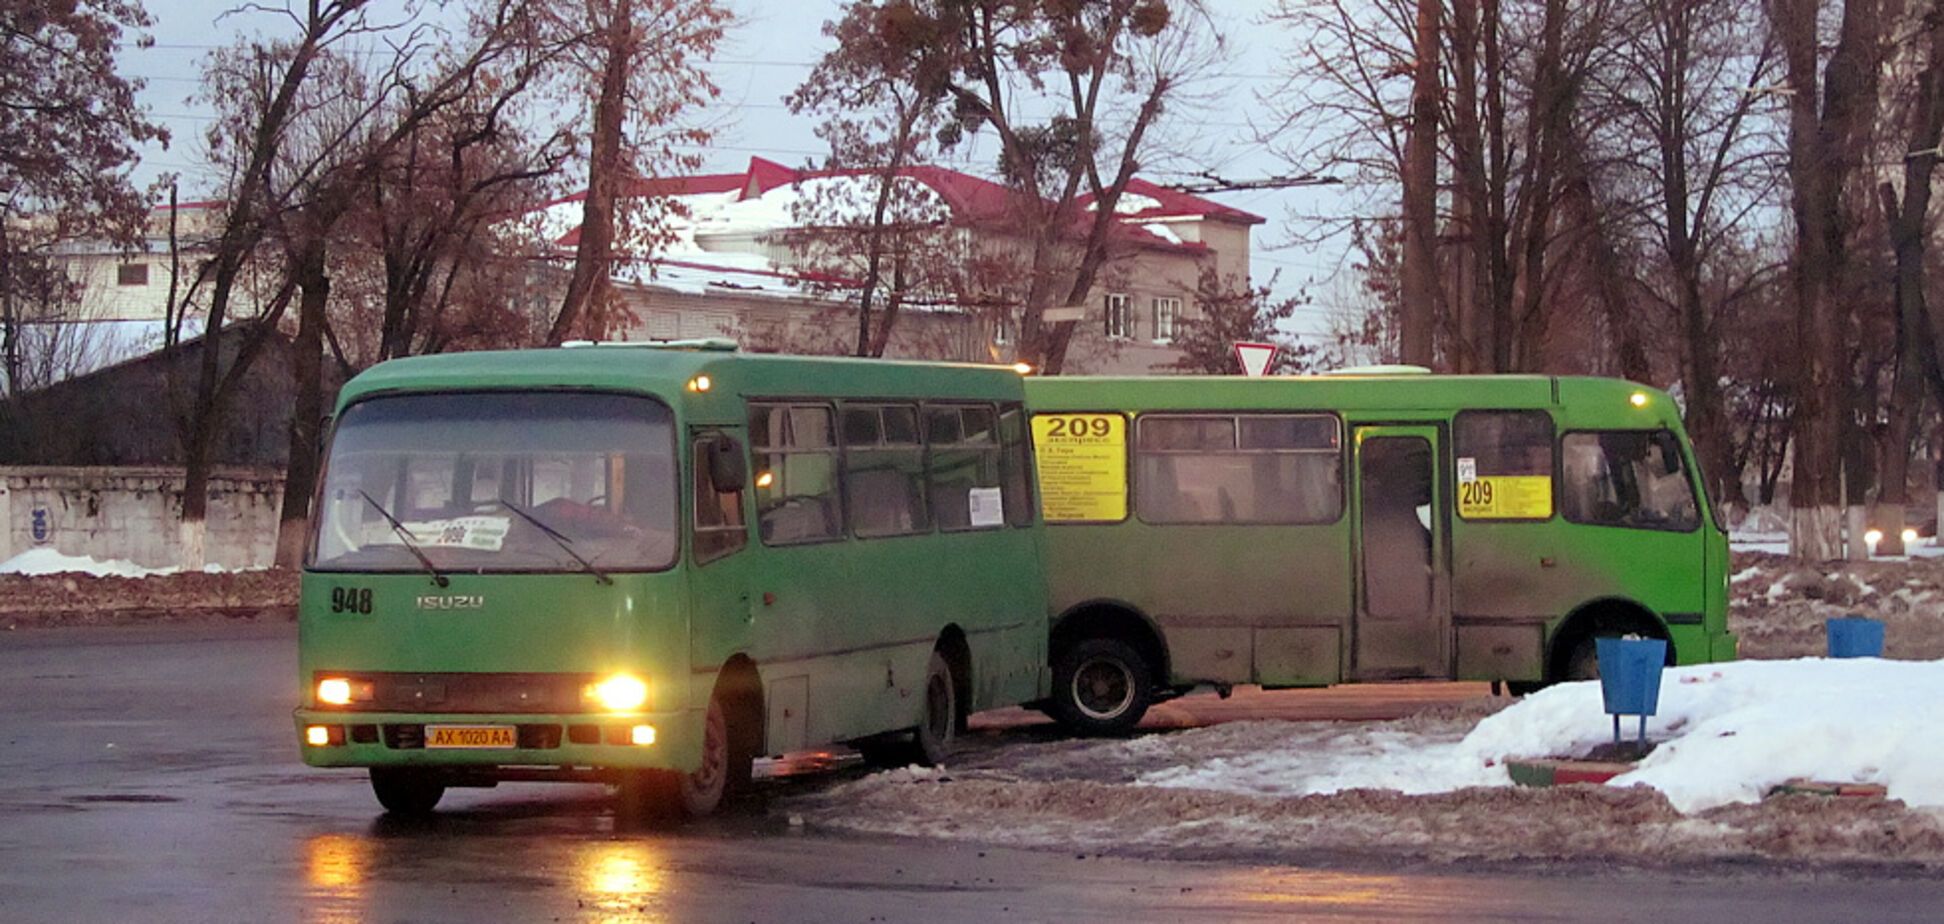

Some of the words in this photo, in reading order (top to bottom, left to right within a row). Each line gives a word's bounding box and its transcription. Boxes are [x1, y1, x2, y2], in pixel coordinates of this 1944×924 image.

[1047, 417, 1110, 437] 209
[1462, 480, 1493, 505] 209
[332, 587, 373, 614] 948
[416, 595, 484, 609] ISUZU
[435, 730, 455, 744] AX
[457, 730, 489, 744] 1020
[491, 730, 511, 744] AA
